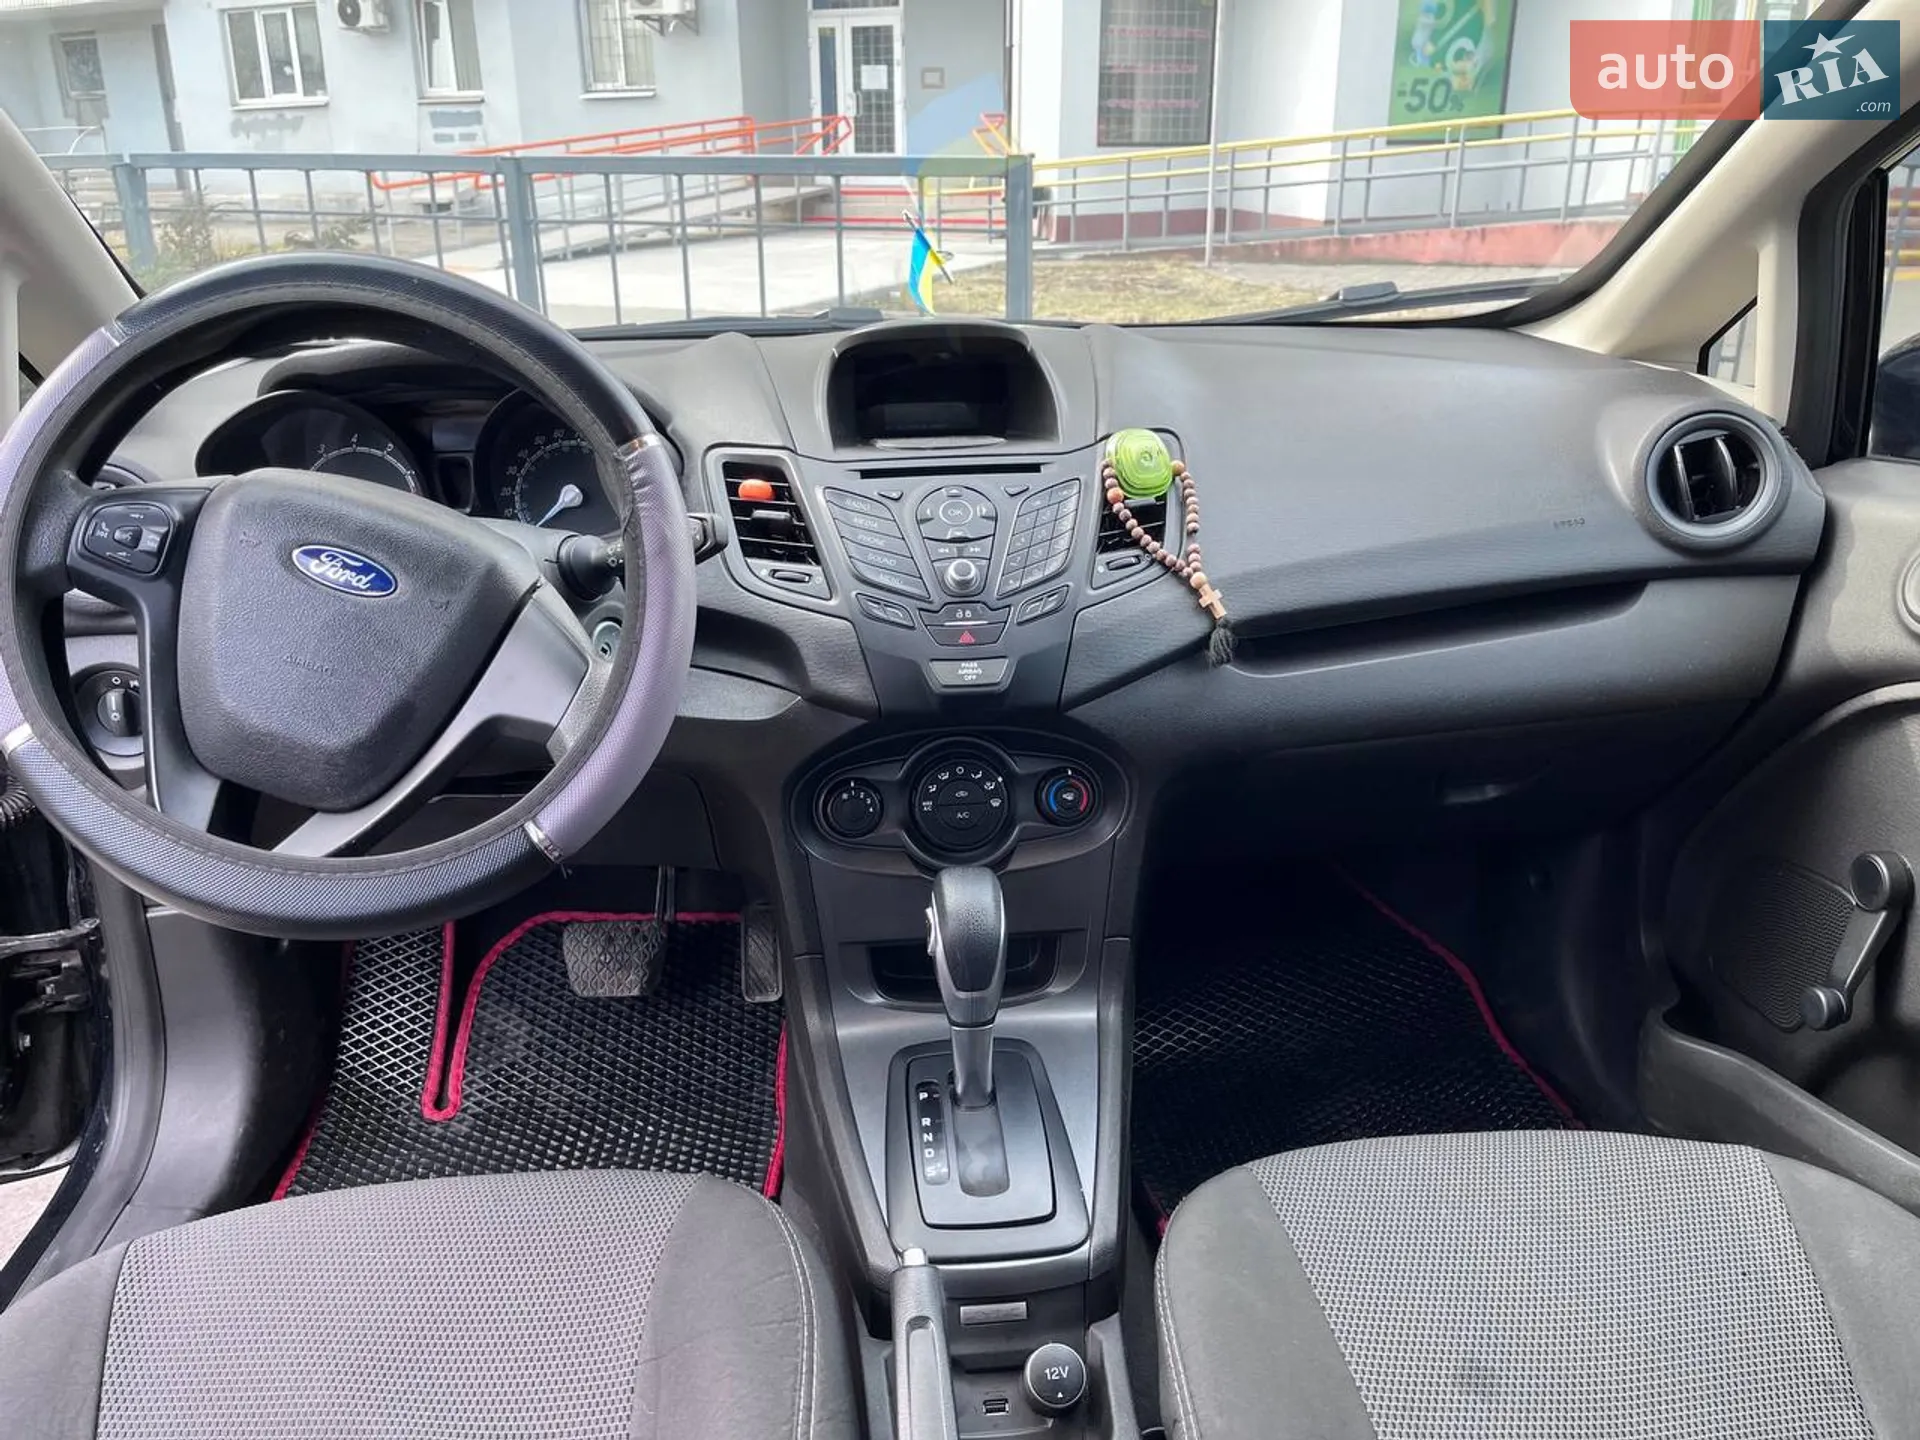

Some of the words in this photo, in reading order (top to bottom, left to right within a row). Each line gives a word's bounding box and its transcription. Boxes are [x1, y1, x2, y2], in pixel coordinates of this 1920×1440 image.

[947, 508, 963, 516] OK
[310, 551, 376, 589] Ford
[919, 1092, 928, 1100] P
[921, 1117, 931, 1127] R
[923, 1132, 933, 1142] N
[924, 1148, 935, 1158] D
[1044, 1365, 1069, 1380] 12V
